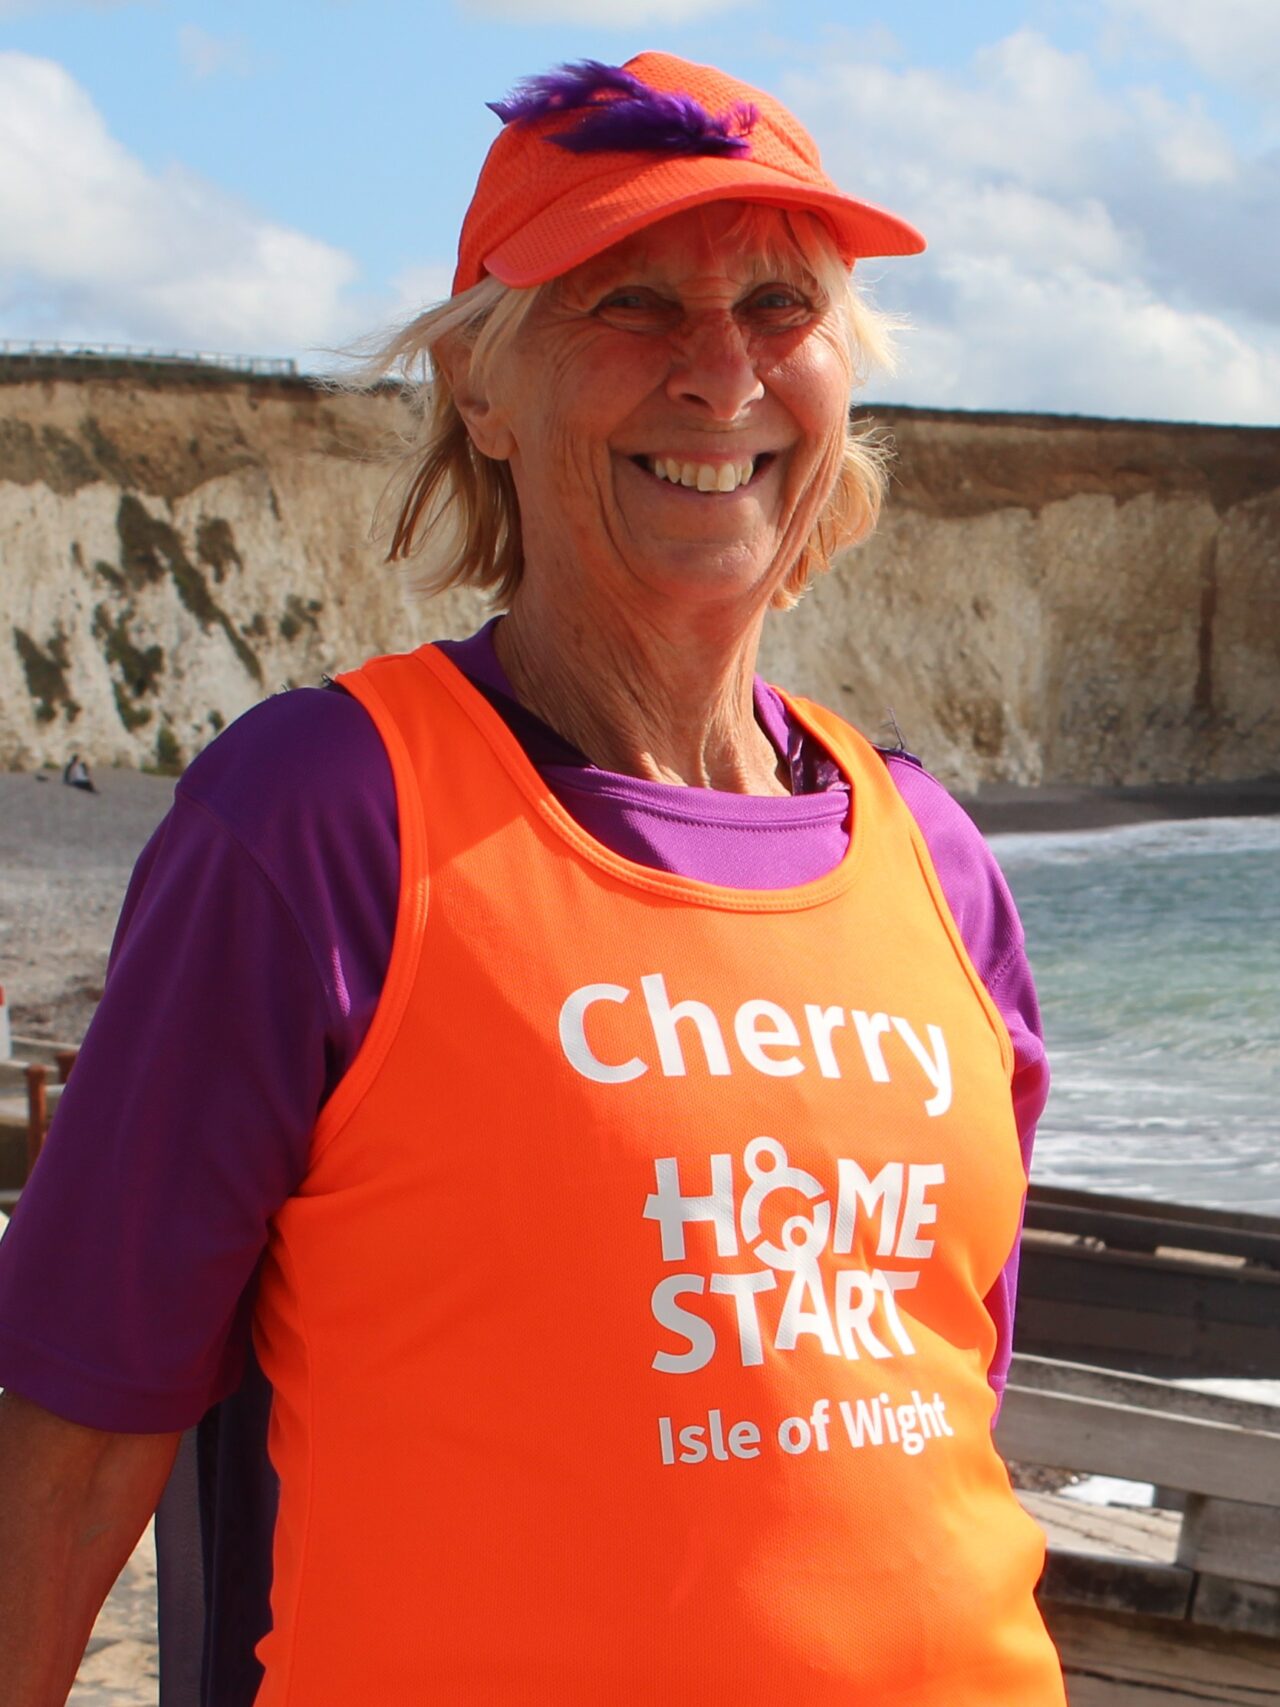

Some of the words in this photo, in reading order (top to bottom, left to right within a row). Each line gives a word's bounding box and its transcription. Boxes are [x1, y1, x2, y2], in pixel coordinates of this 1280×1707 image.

[558, 973, 953, 1117] Cherry
[642, 1136, 946, 1270] HOME
[650, 1262, 920, 1374] START
[658, 1409, 761, 1465] Isle
[777, 1398, 830, 1455] of
[839, 1389, 954, 1456] Wight
